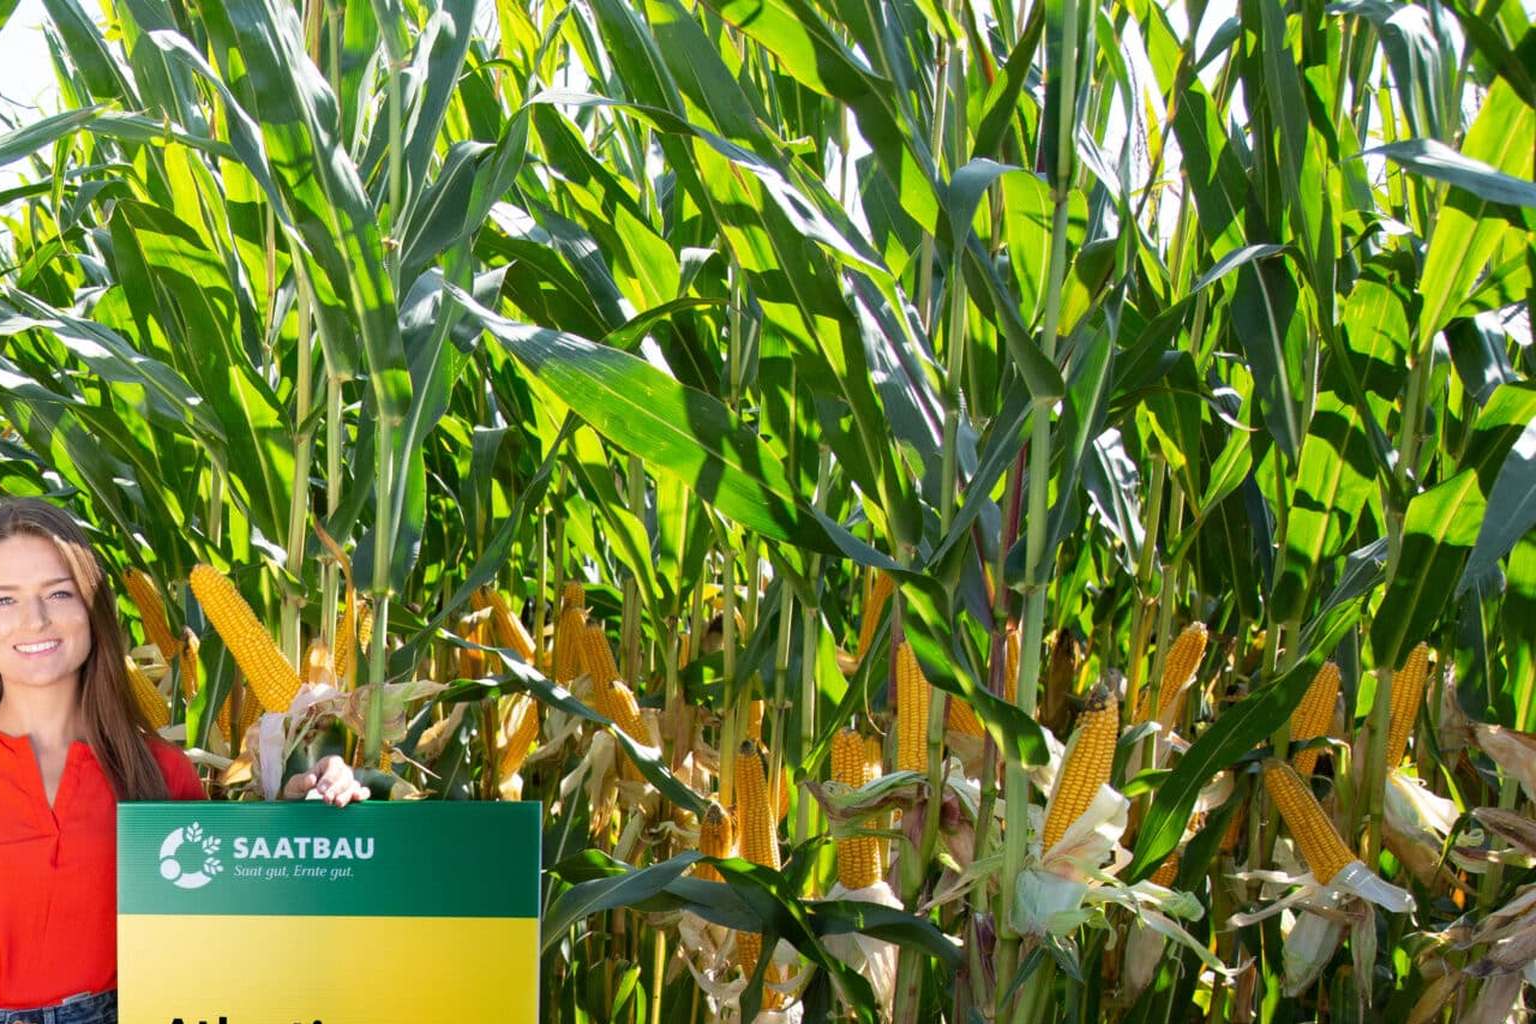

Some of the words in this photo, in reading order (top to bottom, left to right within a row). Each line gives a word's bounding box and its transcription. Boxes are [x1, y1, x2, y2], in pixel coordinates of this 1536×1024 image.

[233, 837, 375, 860] SAATBAU
[234, 864, 261, 877] Saat
[294, 866, 327, 878] Ernte
